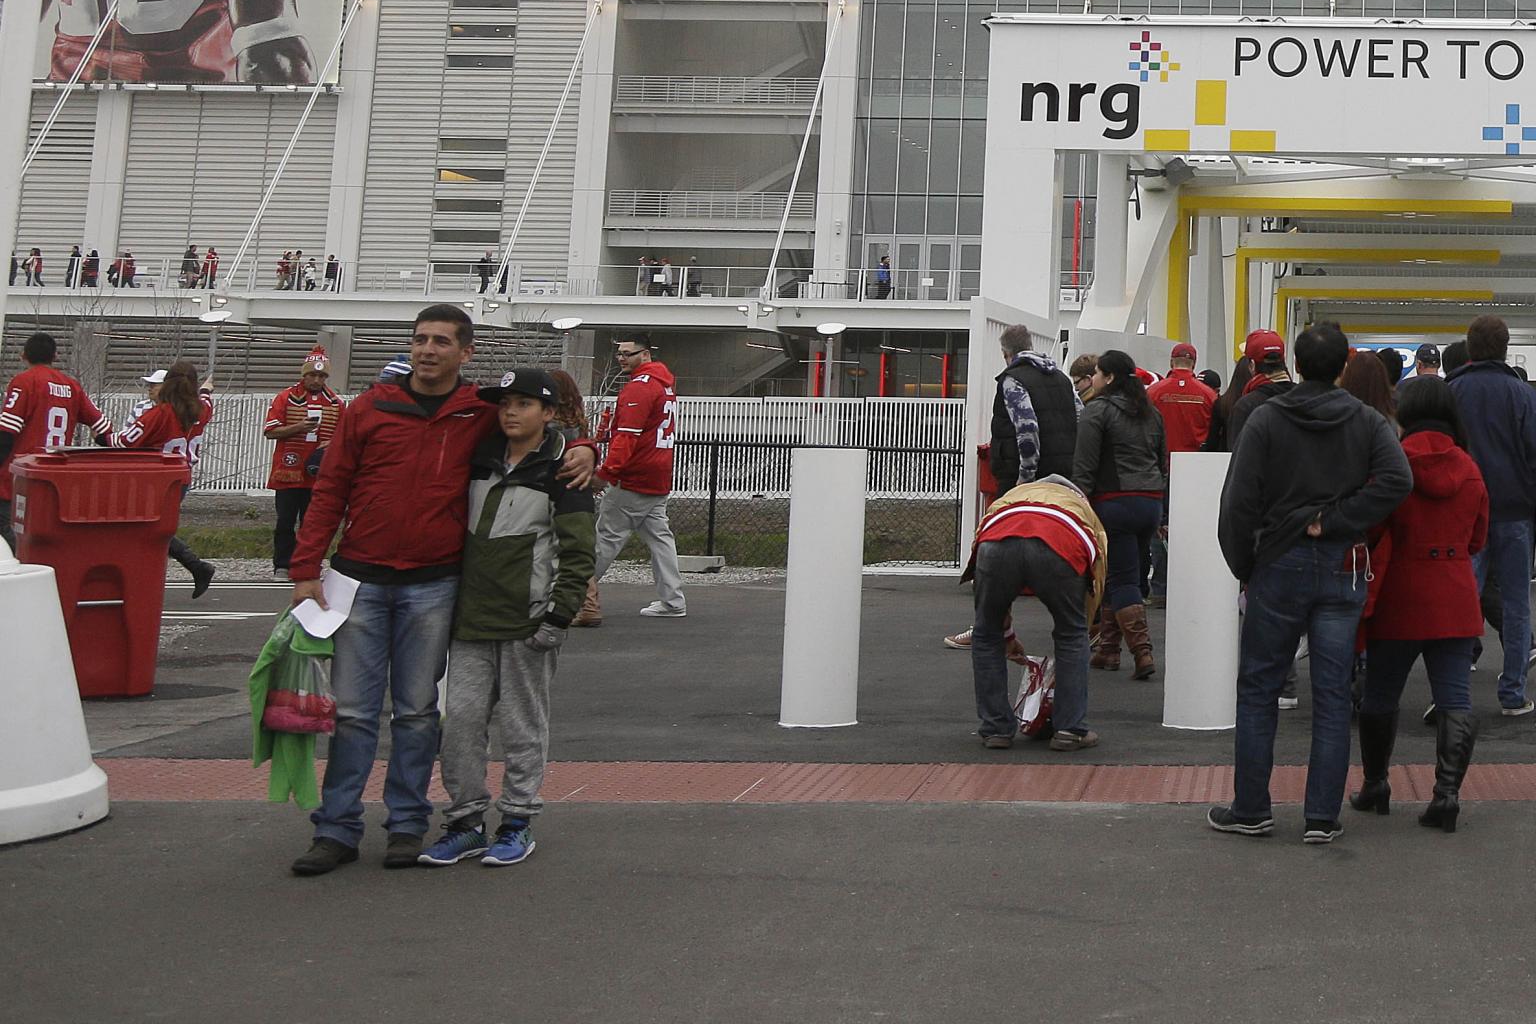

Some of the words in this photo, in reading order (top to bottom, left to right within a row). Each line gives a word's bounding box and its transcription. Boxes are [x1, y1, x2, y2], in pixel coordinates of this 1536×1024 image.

[1234, 36, 1430, 79] POWER
[1447, 40, 1525, 81] TO
[1020, 81, 1141, 140] nrg
[45, 406, 69, 453] 8
